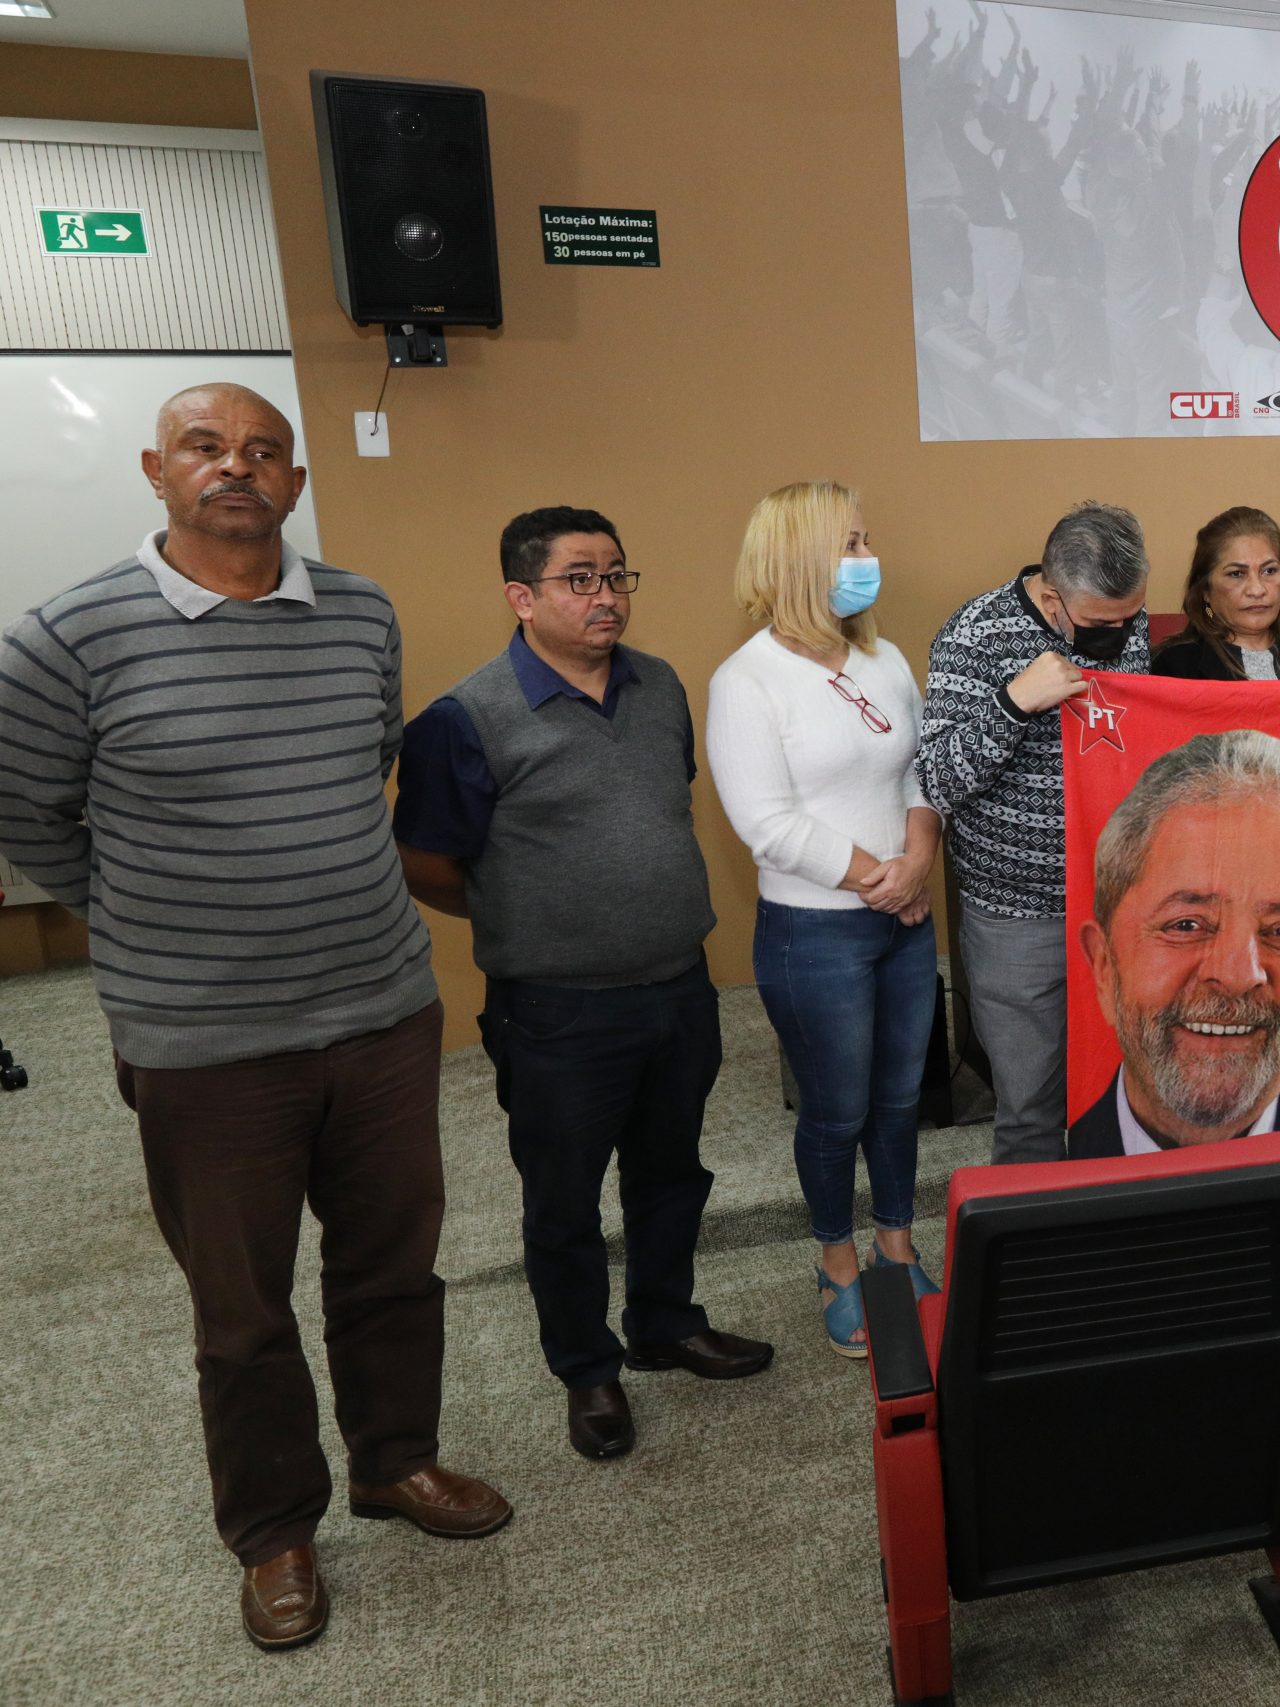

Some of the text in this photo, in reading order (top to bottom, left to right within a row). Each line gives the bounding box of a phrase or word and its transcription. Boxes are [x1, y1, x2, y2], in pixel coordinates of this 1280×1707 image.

[544, 213, 653, 228] Lotação Máxima:
[610, 234, 653, 243] sentadas
[553, 245, 570, 258] 30
[574, 248, 613, 257] pessoas
[633, 250, 645, 260] pé
[1171, 395, 1232, 417] CUT
[1088, 704, 1115, 730] PT
